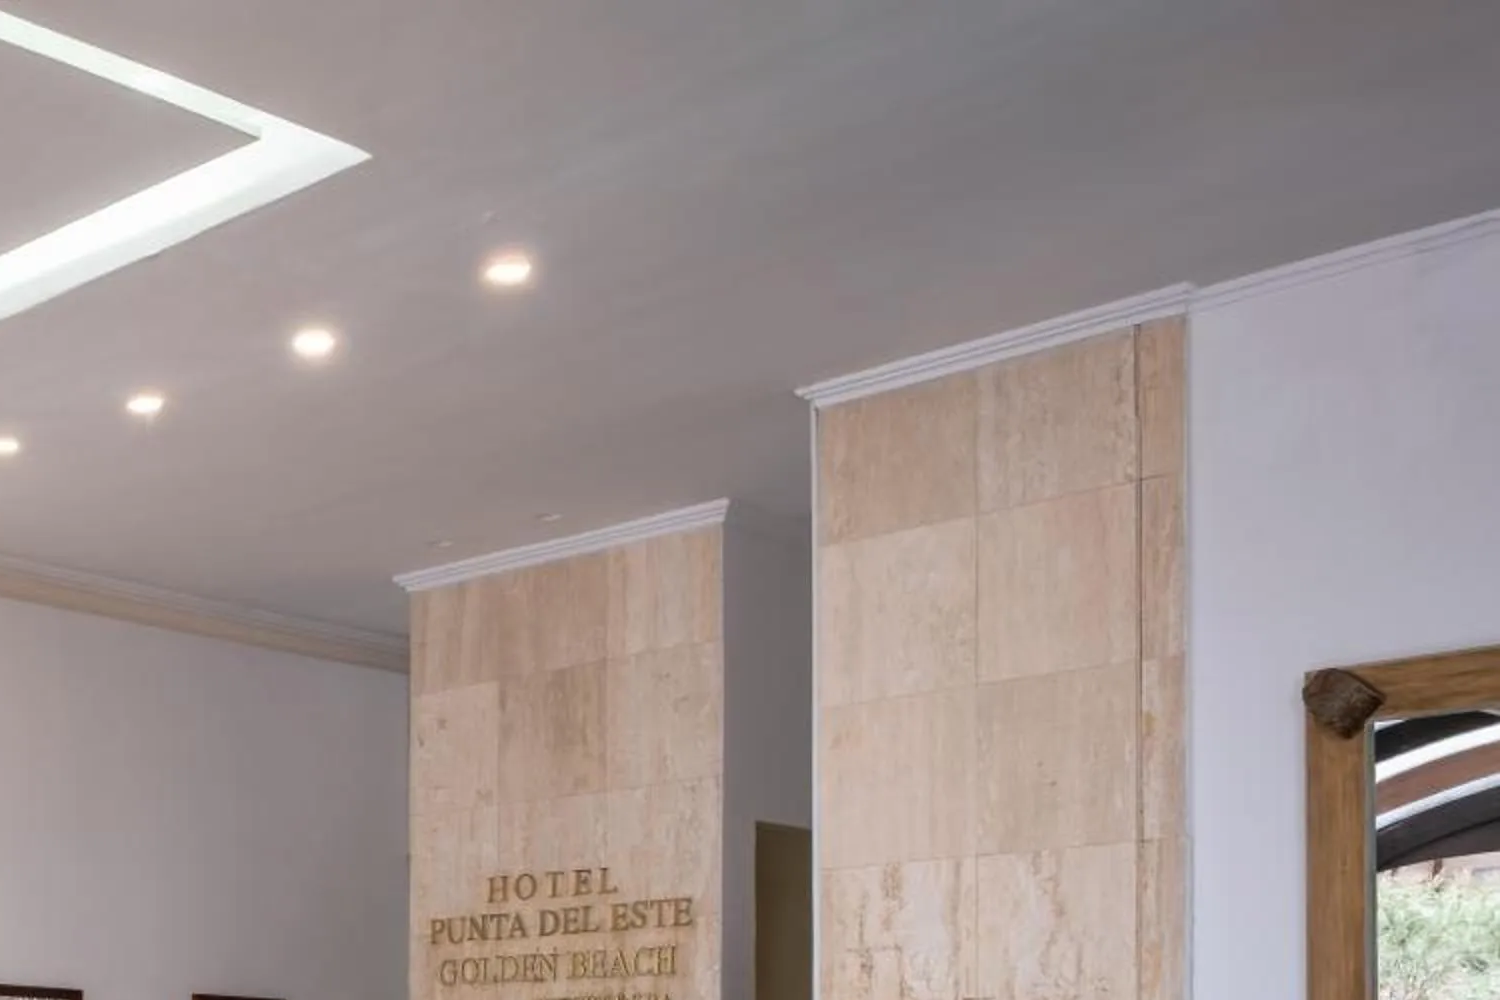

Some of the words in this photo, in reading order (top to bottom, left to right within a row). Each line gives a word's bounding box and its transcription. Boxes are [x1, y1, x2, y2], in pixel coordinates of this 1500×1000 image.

[487, 867, 618, 903] HOTEL
[430, 913, 527, 945] PUNTA
[538, 905, 600, 937] DEL
[610, 897, 693, 932] ESTE
[439, 953, 559, 987] GOLDEN
[567, 945, 676, 980] BEACH
